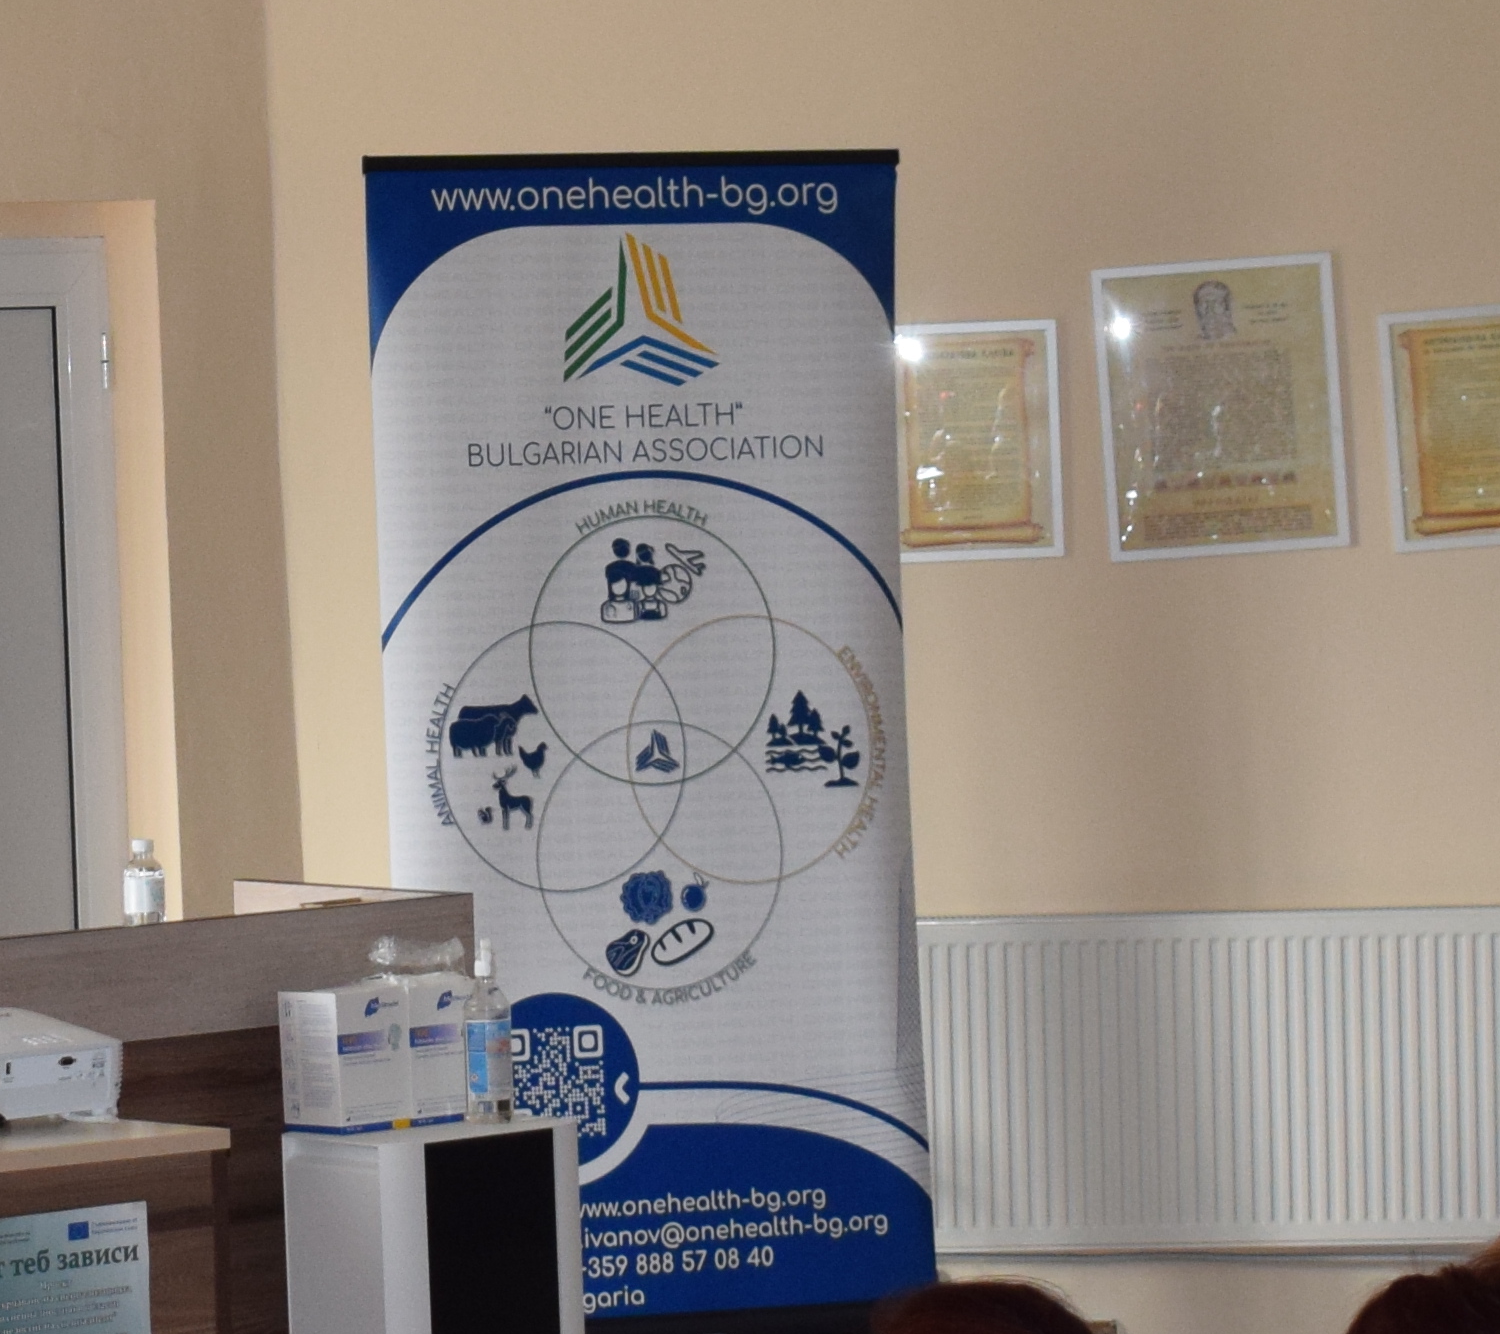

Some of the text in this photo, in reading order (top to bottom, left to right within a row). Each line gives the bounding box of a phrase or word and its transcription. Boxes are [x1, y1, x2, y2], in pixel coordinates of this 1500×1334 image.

[431, 176, 840, 214] www.onehealth-bg.org
[467, 434, 825, 470] BULGARIAN ASSOCIATION
[575, 498, 710, 535] HUMAN HEALTH
[425, 682, 456, 826] ANIMAL HEALTH
[835, 794, 879, 859] HEALTH
[583, 951, 758, 1006] FOOD & AGRICULTURE
[10, 1248, 51, 1277] теб
[56, 1243, 140, 1271] зависи
[636, 1251, 675, 1276] 888
[682, 1249, 708, 1273] 57
[714, 1247, 740, 1271] 08
[746, 1245, 774, 1267] 40
